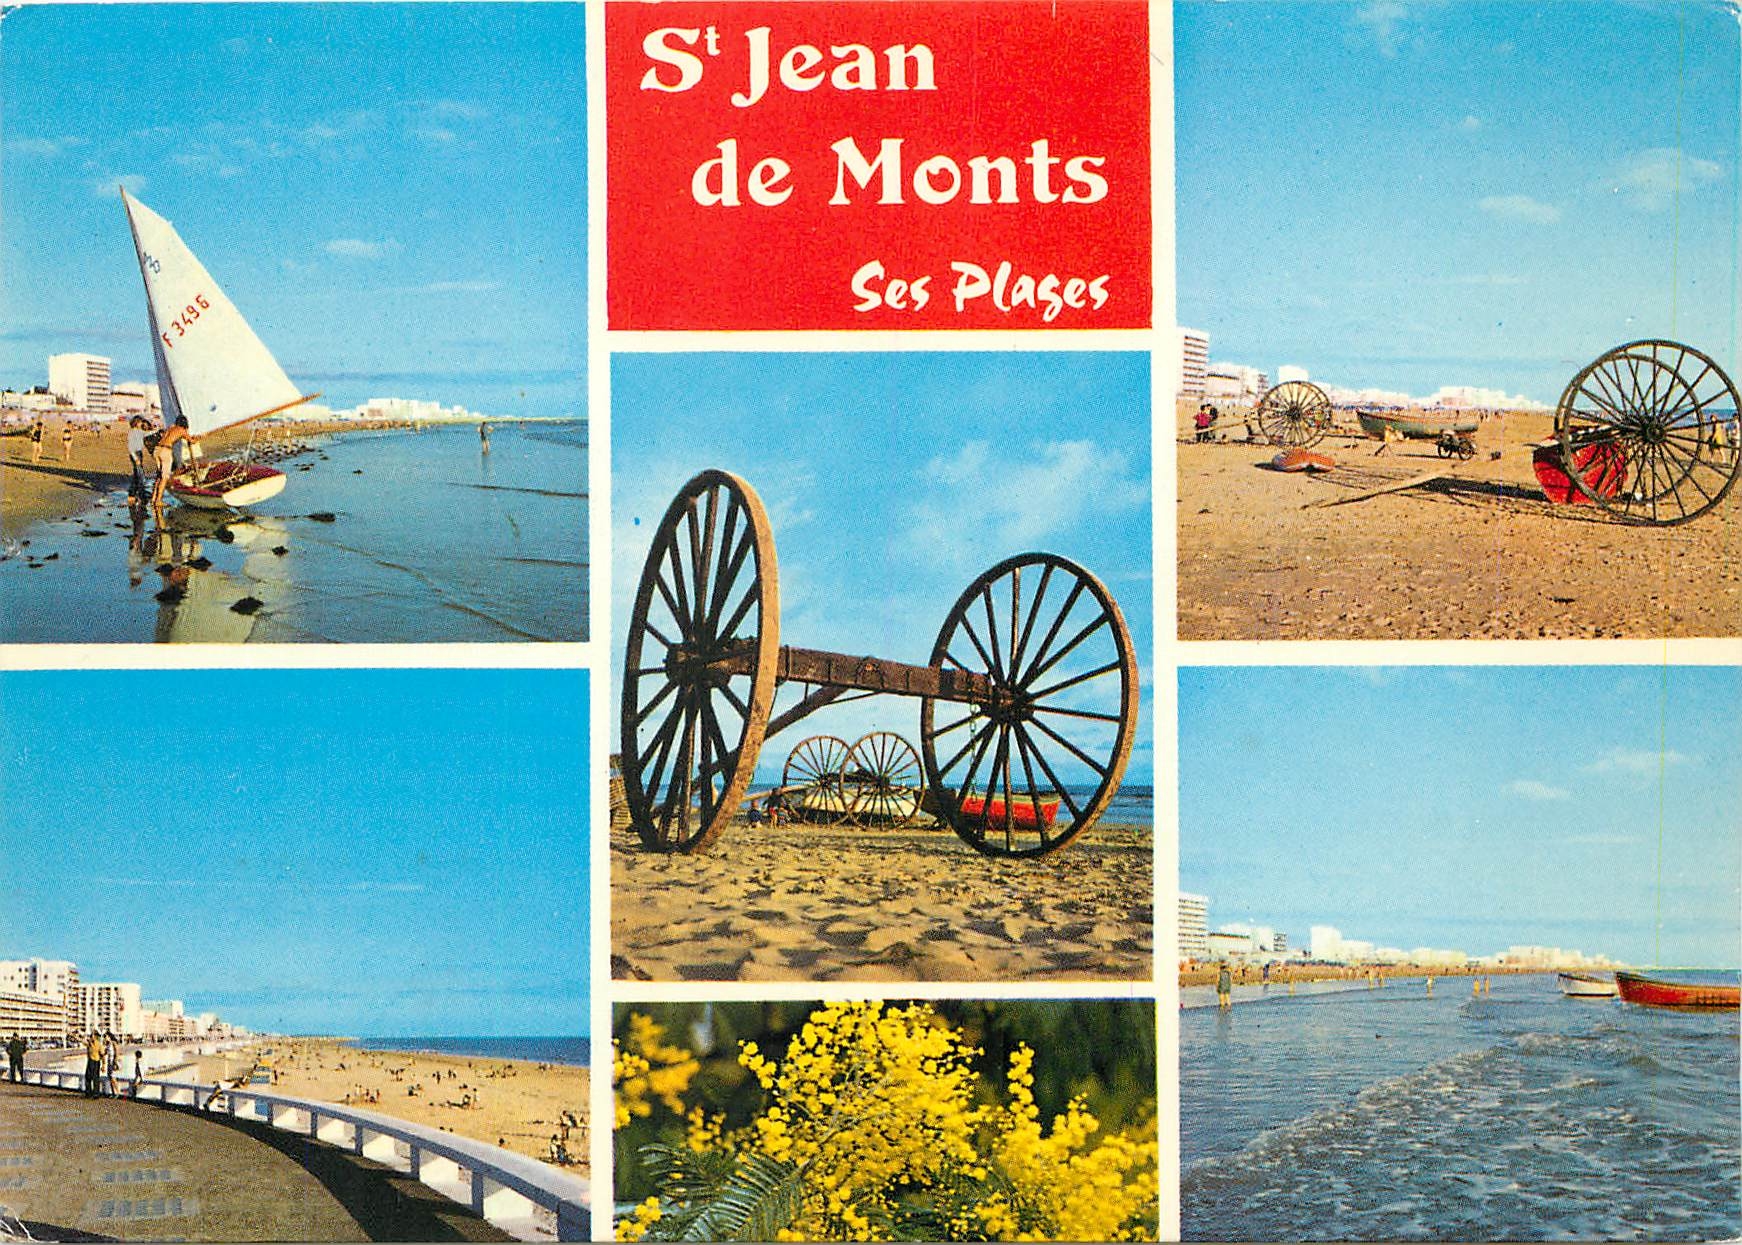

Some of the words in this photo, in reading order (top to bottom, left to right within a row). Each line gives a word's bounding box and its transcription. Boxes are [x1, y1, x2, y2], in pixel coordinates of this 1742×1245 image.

[731, 27, 937, 108] Jean
[692, 139, 794, 206] de
[829, 137, 1109, 205] Monts
[851, 260, 932, 312] Ses
[951, 261, 1110, 322] Plages
